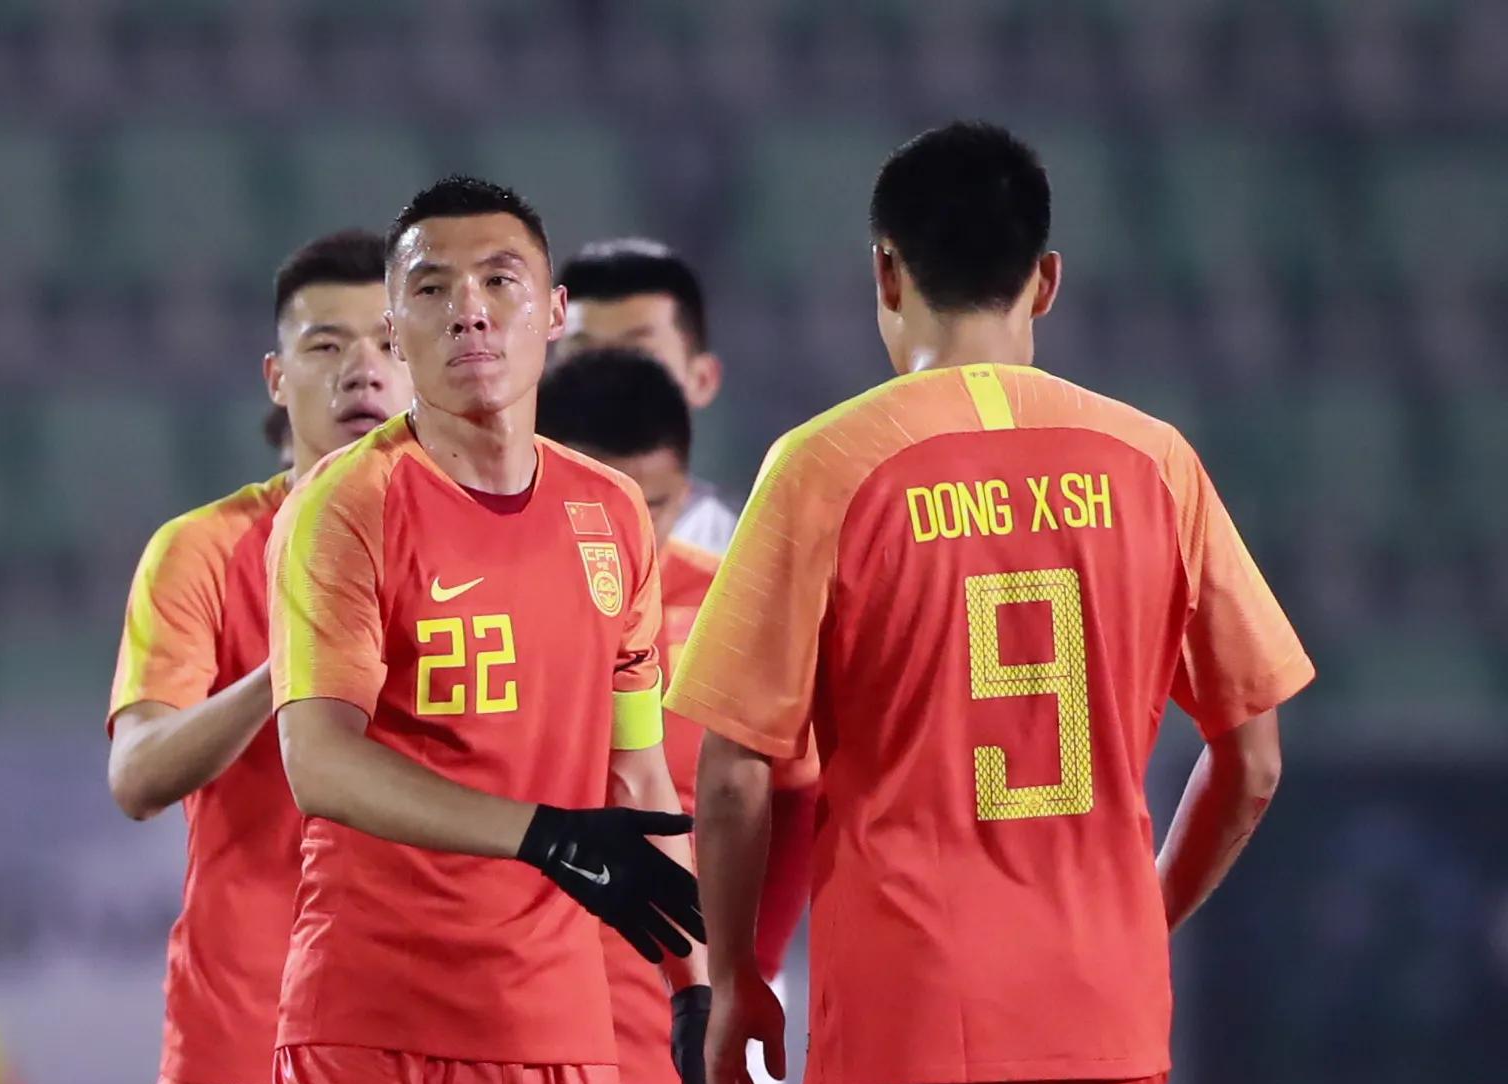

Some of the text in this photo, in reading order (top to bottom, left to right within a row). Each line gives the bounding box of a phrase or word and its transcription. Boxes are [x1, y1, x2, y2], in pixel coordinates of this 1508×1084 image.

[906, 472, 1113, 543] DONG X SH
[416, 613, 519, 716] 22
[965, 567, 1095, 821] 9
